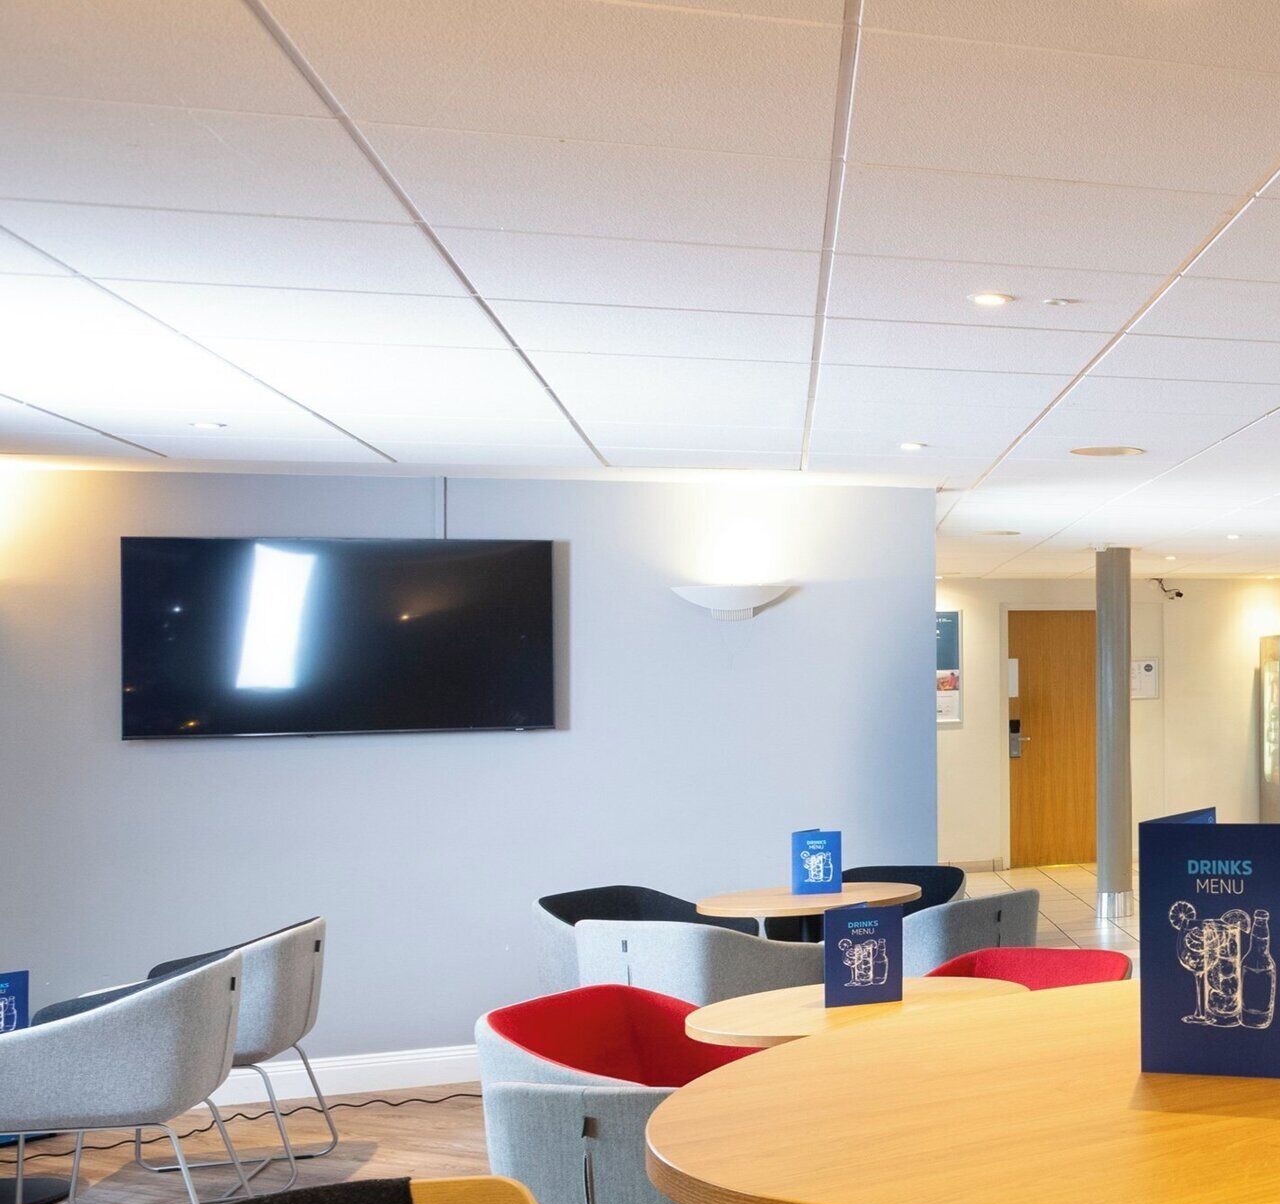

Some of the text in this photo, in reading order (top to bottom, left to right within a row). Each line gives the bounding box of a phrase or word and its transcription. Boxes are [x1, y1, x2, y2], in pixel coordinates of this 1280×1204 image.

[1187, 860, 1253, 875] DRINKS
[1196, 878, 1244, 895] MENU
[847, 920, 879, 929] DRINKS
[851, 928, 875, 936] MENU
